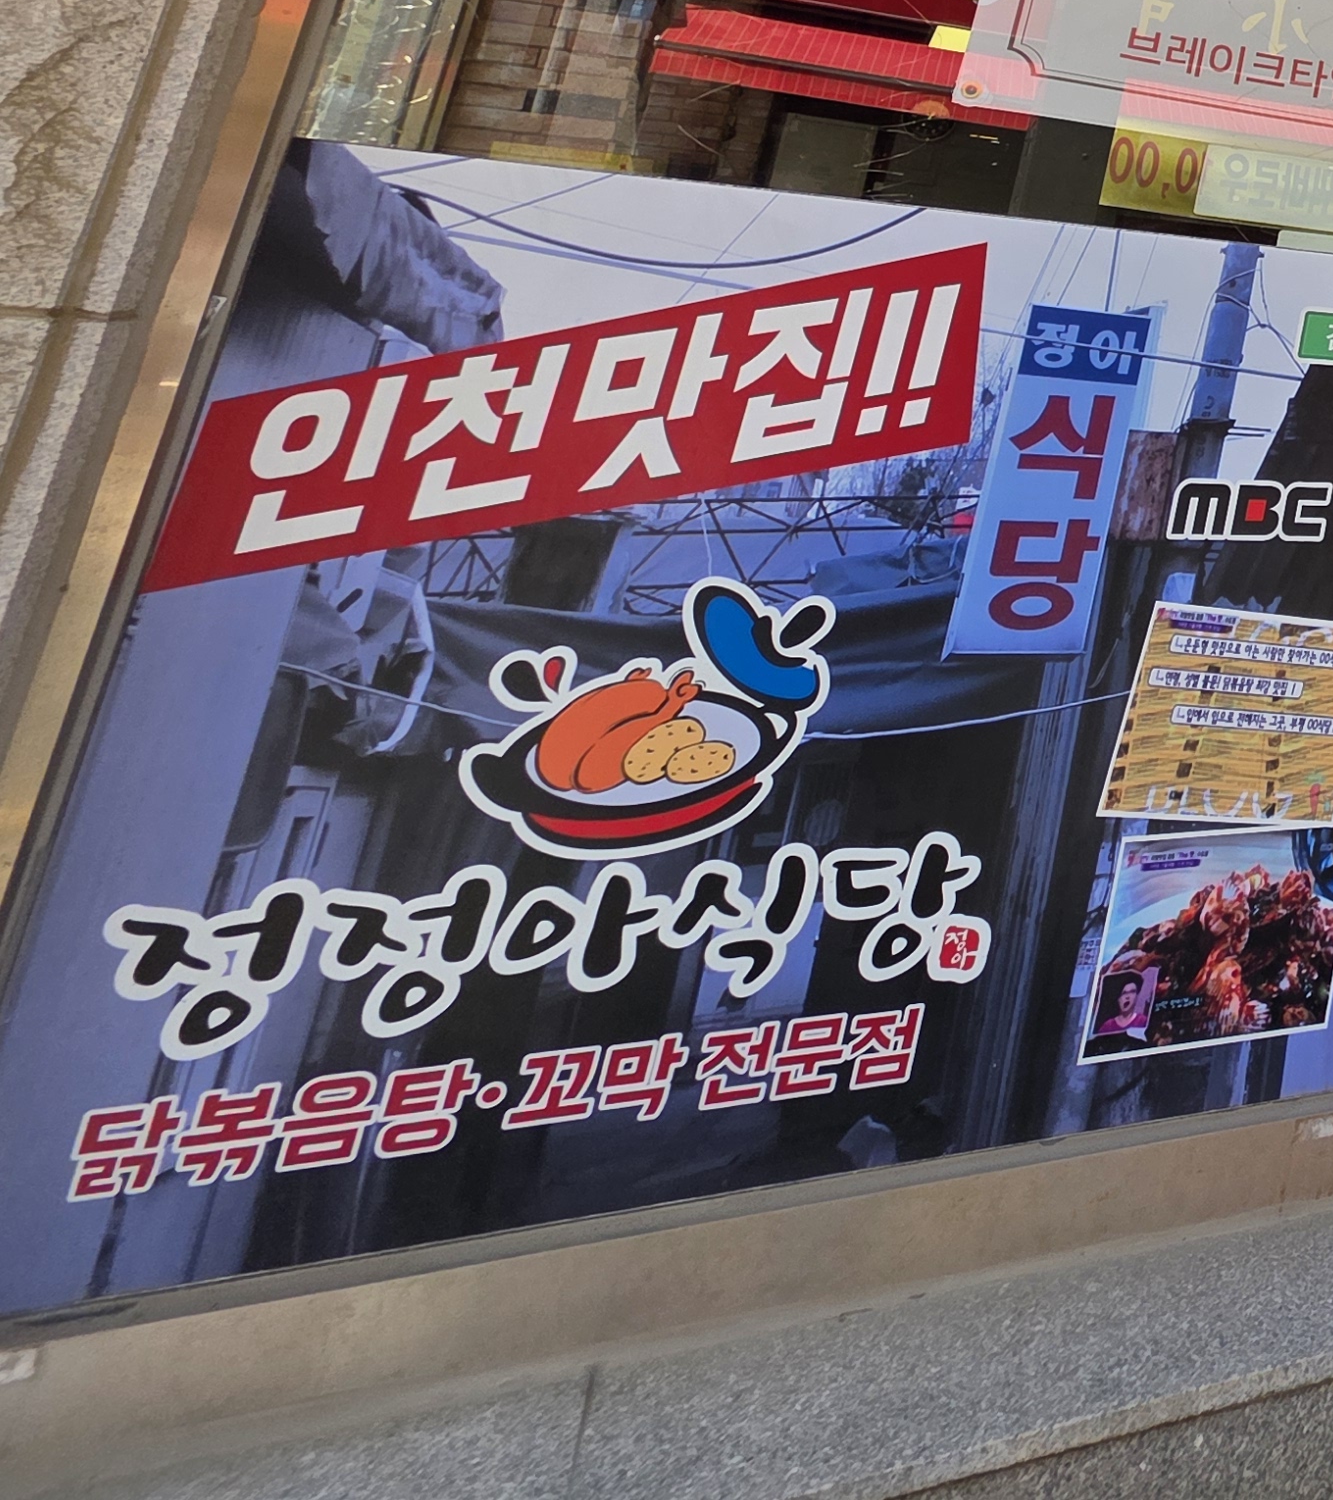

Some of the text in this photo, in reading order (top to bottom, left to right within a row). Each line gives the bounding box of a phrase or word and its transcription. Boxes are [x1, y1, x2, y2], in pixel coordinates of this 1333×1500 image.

[1031, 321, 1140, 376] 정아
[233, 281, 962, 556] 인천맛집!!
[988, 394, 1117, 632] 식당
[1169, 480, 1331, 540] MBC
[108, 834, 982, 1060] 정정아식당
[941, 925, 978, 972] 정아
[696, 1002, 926, 1113] 전문점
